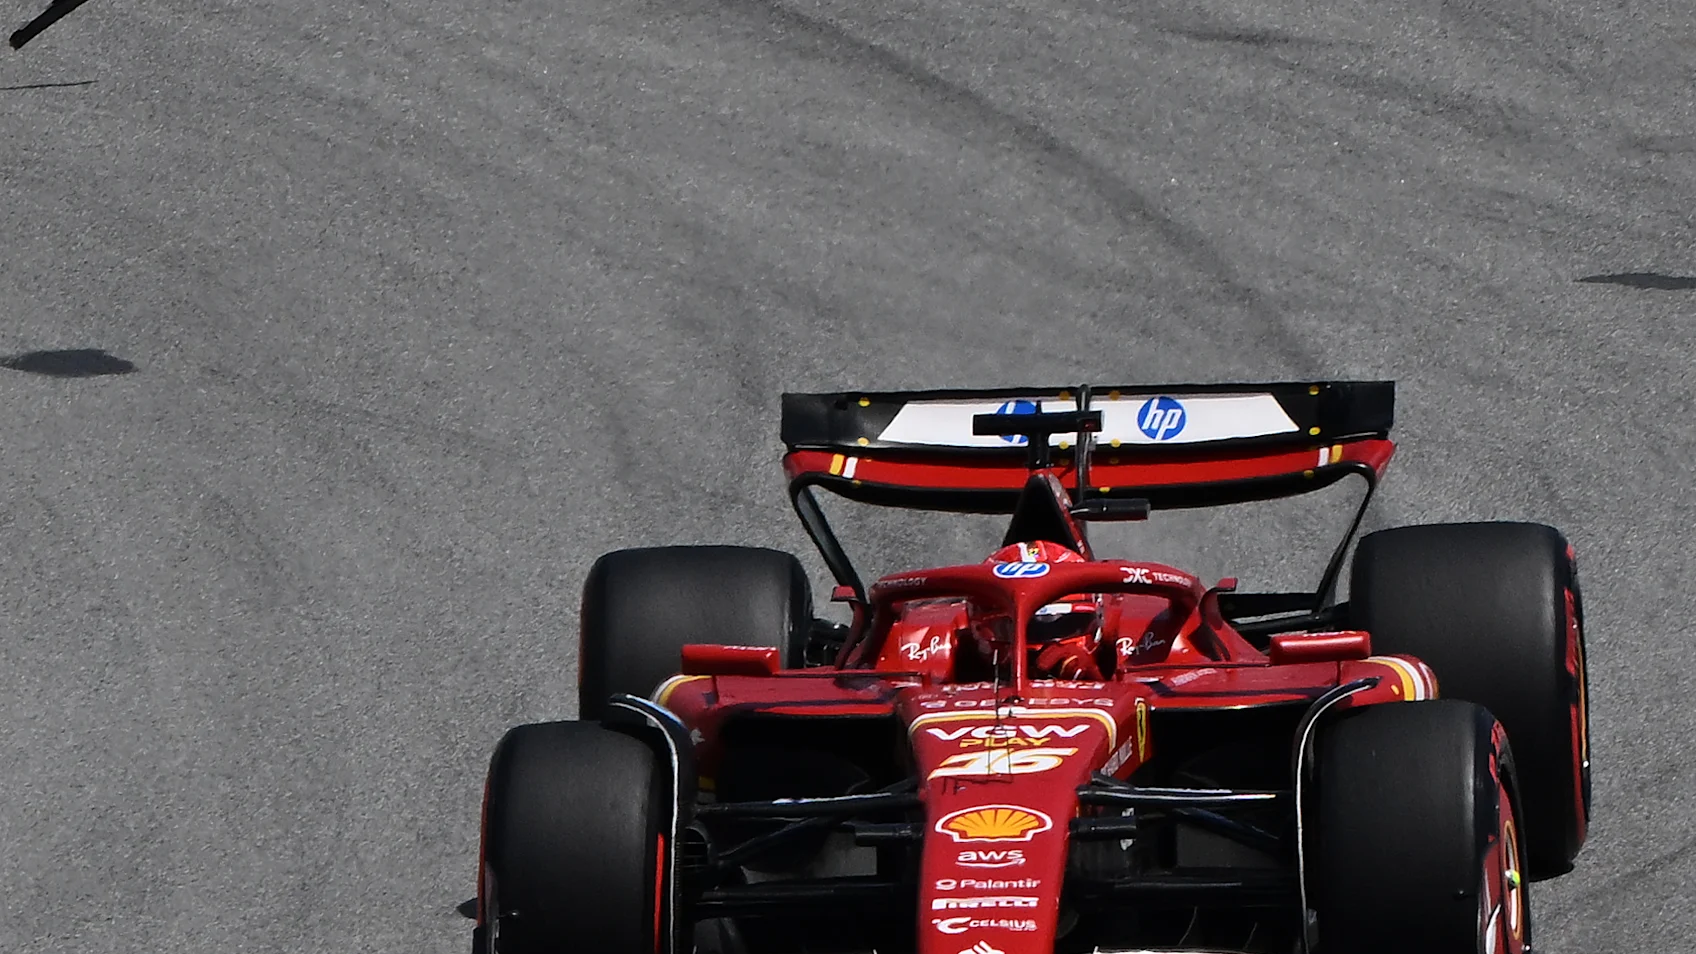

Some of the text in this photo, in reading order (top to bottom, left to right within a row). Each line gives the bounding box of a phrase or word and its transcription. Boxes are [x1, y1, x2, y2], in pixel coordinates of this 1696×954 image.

[1140, 396, 1184, 440] hp
[926, 725, 1091, 741] VGW
[959, 737, 1053, 748] PLAY
[927, 747, 1079, 781] 16
[957, 850, 1025, 864] aws
[959, 878, 1042, 889] Palantir
[931, 896, 1039, 910] PIRELLI
[968, 919, 1038, 930] CELSIUS
